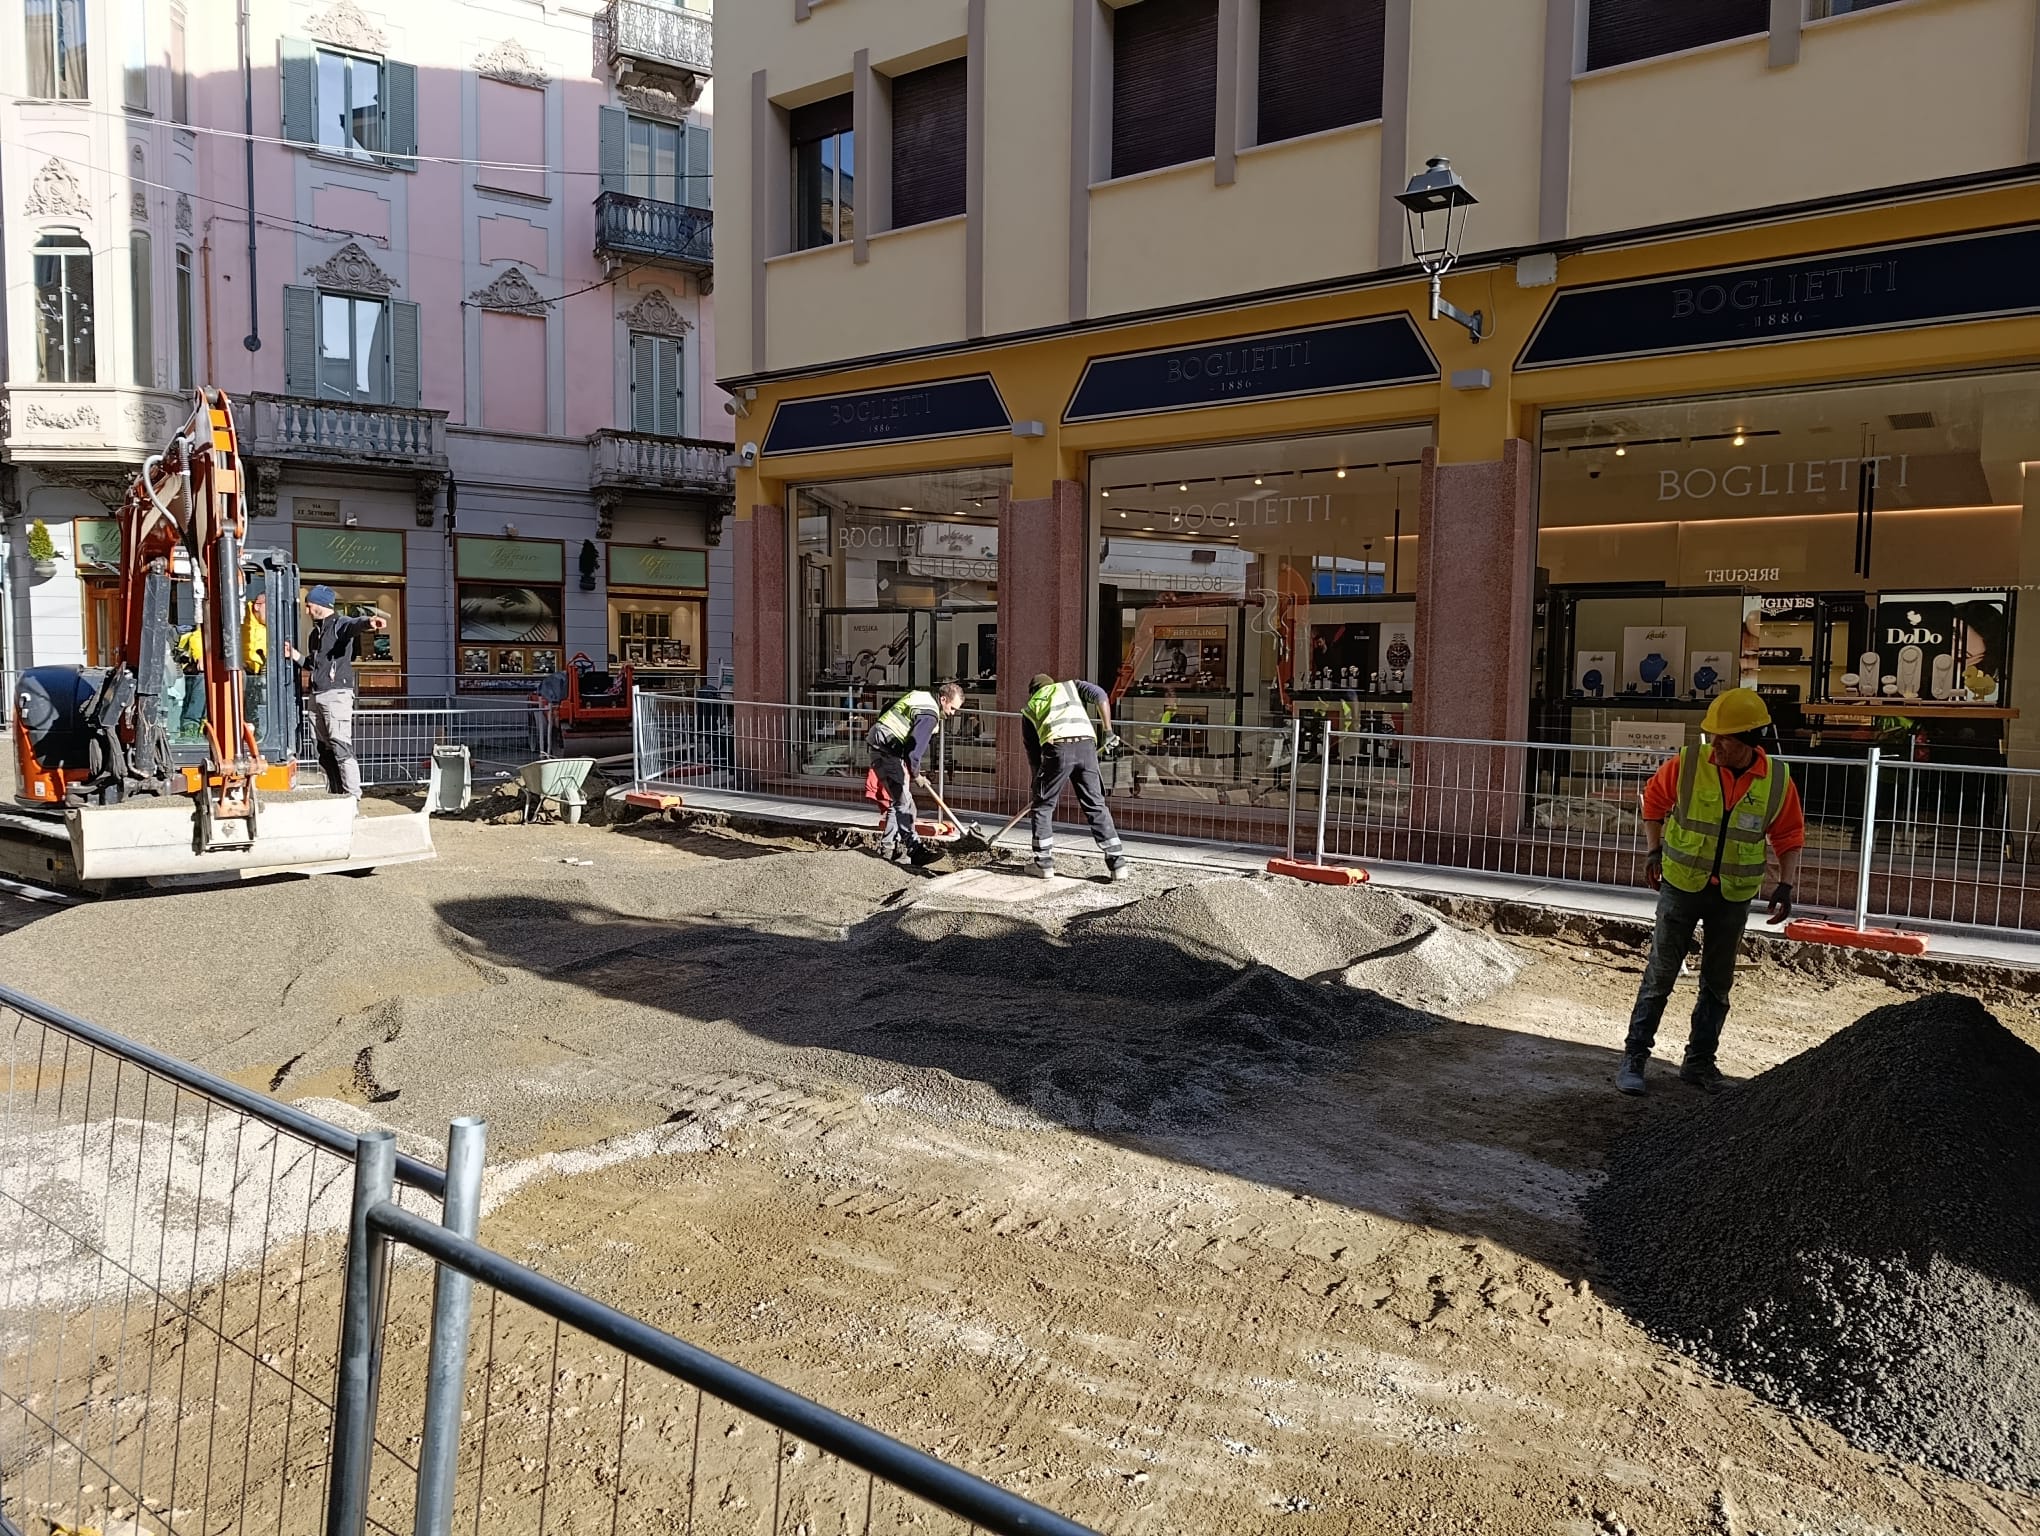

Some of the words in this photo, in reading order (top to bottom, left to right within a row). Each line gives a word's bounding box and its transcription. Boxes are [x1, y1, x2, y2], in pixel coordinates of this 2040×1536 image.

[1672, 259, 1899, 319] BOGLIETTI
[1754, 310, 1804, 328] 1886
[1167, 339, 1313, 384] BOGLIETTI
[1220, 378, 1252, 392] 1886
[1656, 453, 1910, 502] BOGLIETTI
[1168, 494, 1332, 531] BOGLIETTI
[1173, 628, 1218, 637] BREITLING
[1886, 628, 1943, 645] DoDo
